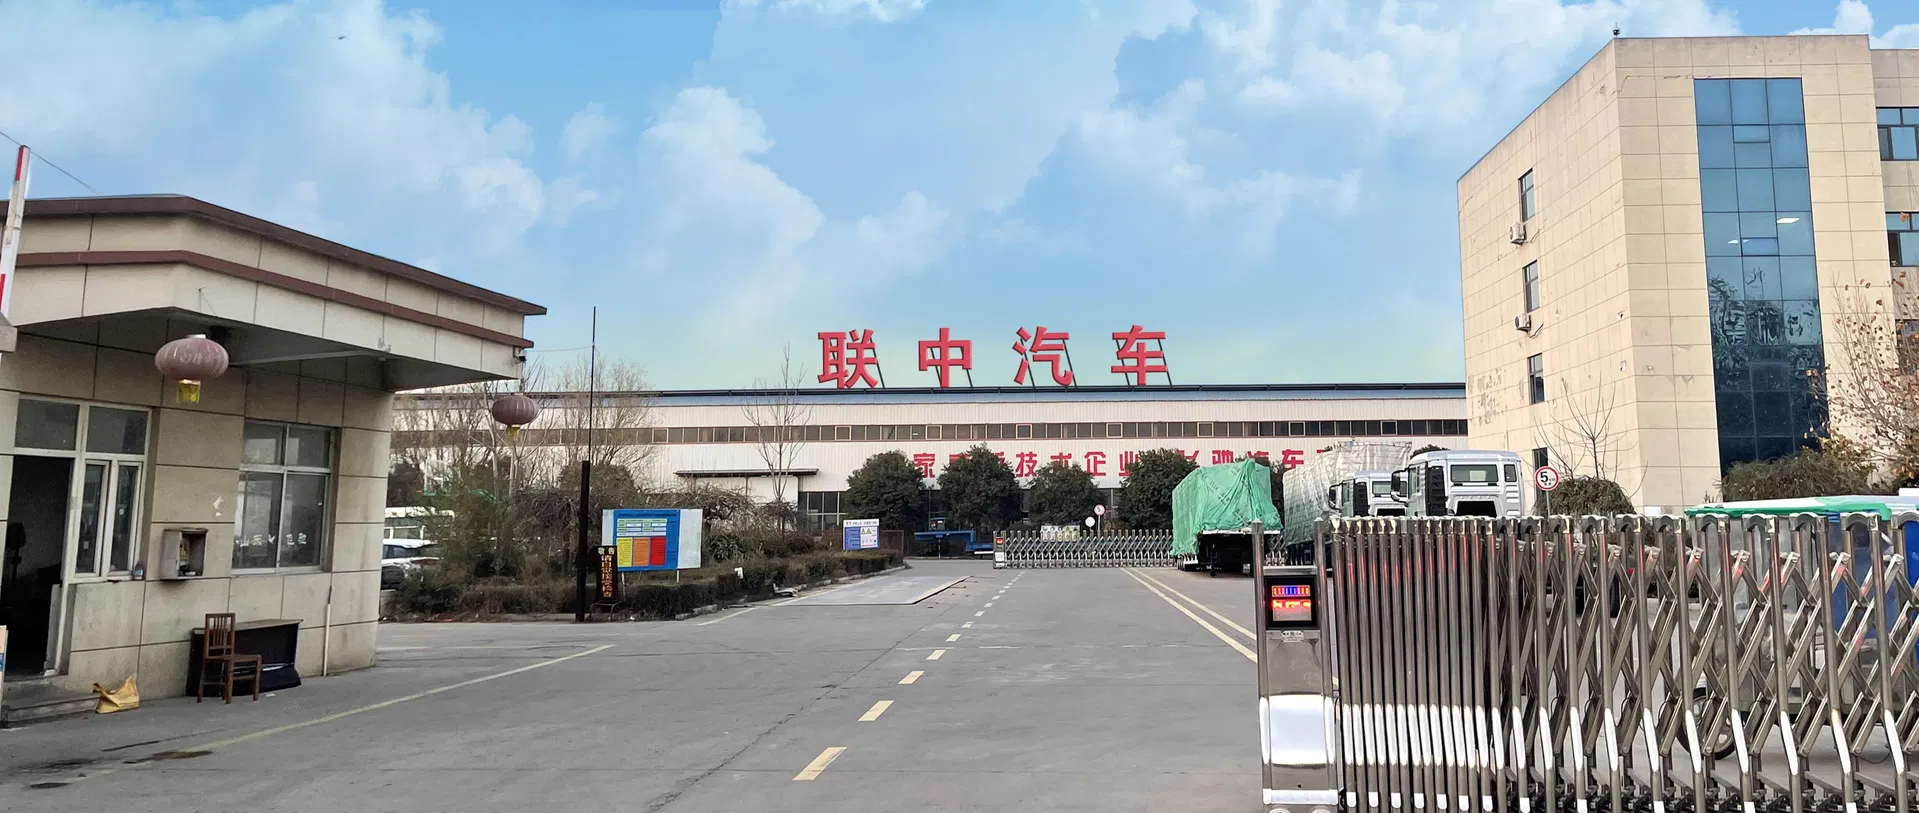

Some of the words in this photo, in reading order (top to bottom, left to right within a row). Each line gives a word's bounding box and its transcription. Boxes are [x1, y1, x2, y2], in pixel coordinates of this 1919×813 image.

[817, 324, 1168, 389] 联中汽车
[1540, 472, 1548, 482] 5
